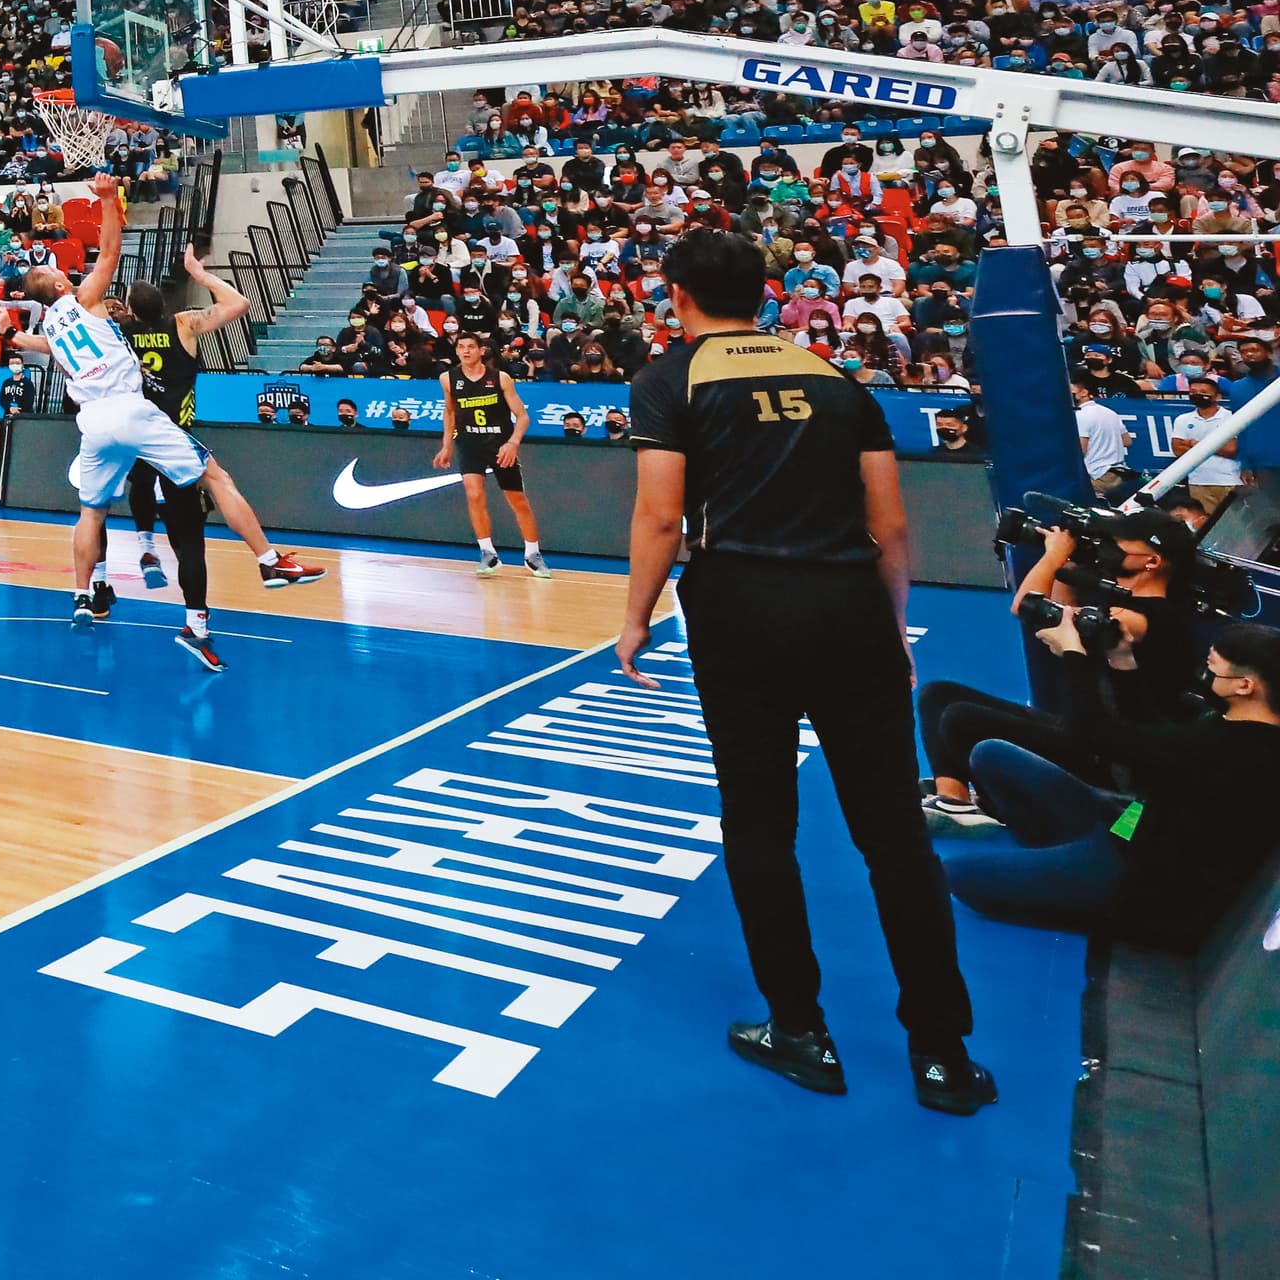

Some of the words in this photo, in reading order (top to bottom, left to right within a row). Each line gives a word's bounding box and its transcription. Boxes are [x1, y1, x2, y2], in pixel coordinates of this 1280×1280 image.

[742, 58, 957, 111] GARED
[55, 323, 104, 372] 14
[133, 334, 170, 348] TUCKER
[474, 409, 487, 426] 6
[752, 389, 813, 422] 15
[37, 767, 725, 1099] BRAVES
